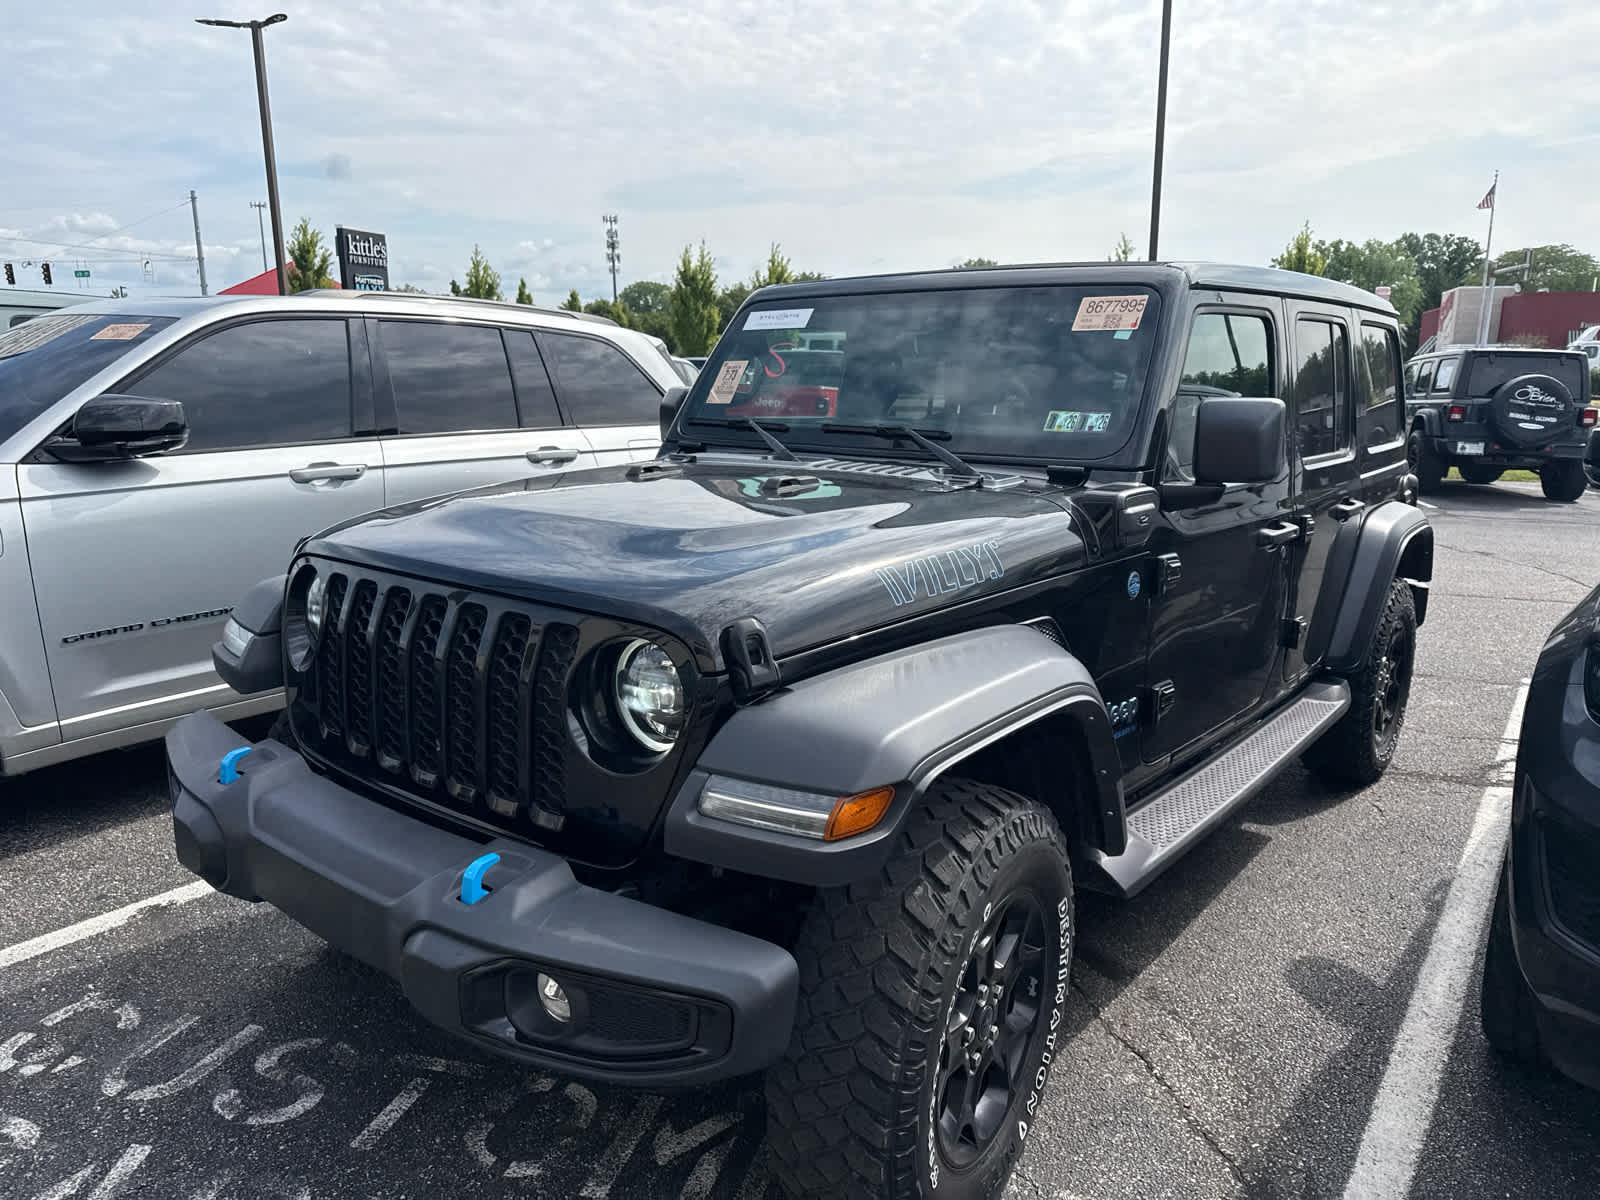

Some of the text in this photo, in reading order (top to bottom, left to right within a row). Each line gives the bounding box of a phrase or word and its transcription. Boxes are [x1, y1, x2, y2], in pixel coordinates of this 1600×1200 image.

[1086, 299, 1146, 314] 8677995
[754, 396, 781, 408] Jeep
[873, 540, 1006, 606] WILLYS
[62, 623, 144, 643] GRAND
[1025, 896, 1070, 1117] DESTINATION
